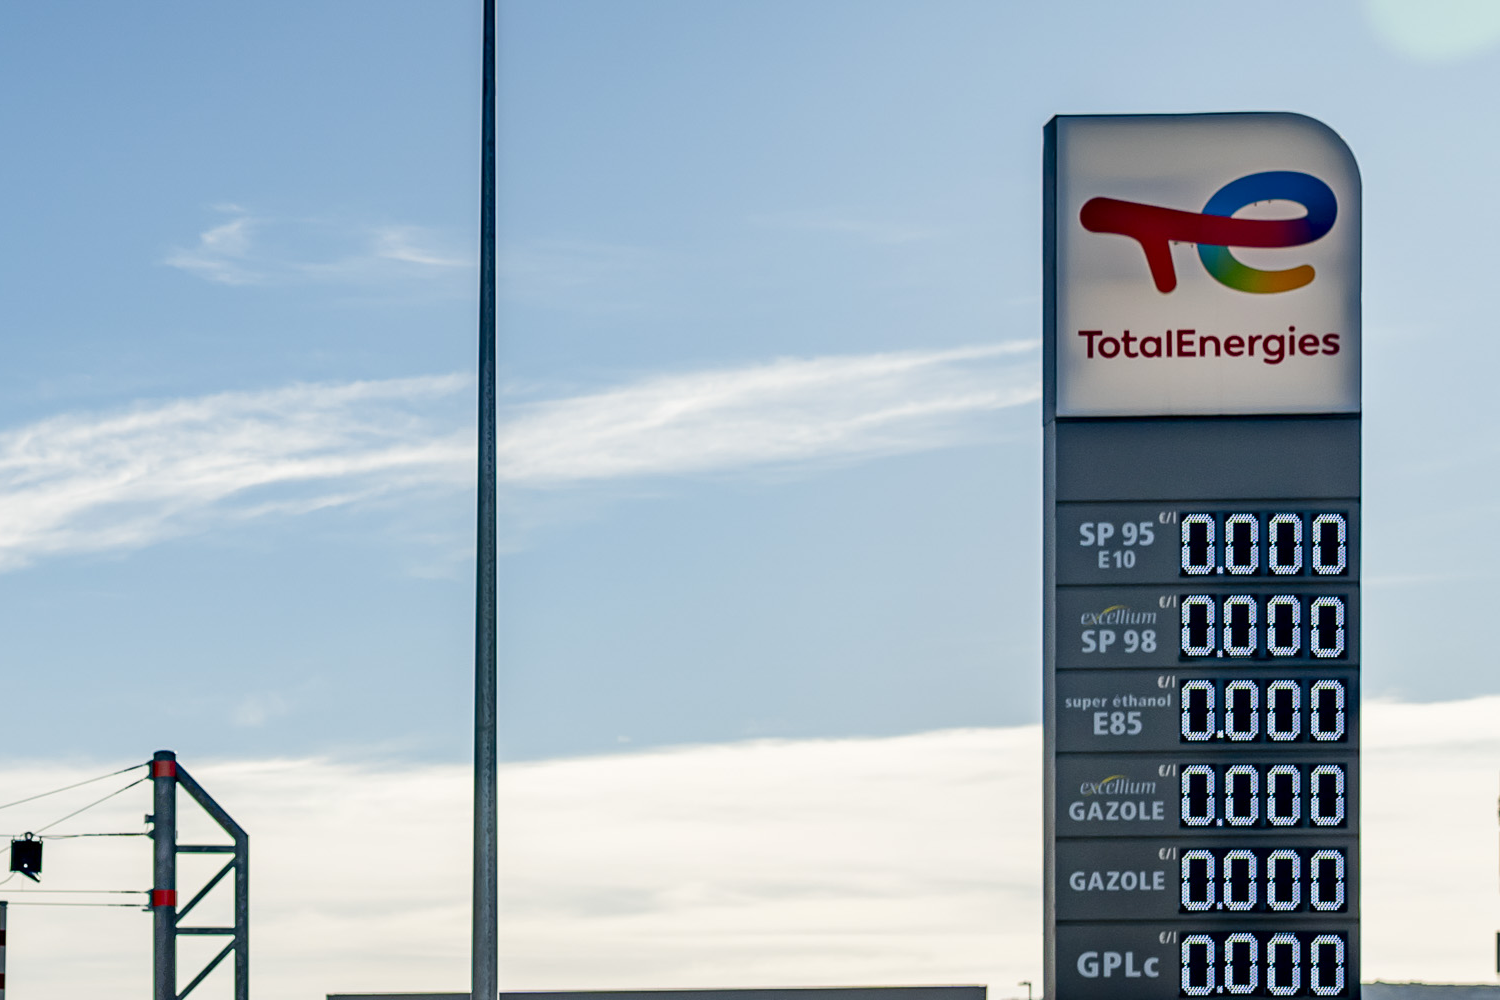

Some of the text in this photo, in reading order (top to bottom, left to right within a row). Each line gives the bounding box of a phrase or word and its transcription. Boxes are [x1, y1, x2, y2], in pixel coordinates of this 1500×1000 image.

[1078, 325, 1340, 365] TotalEnergies
[1079, 521, 1155, 546] SP 95
[1181, 512, 1346, 575] 0.000
[1080, 605, 1157, 626] excellium
[1181, 594, 1346, 658] 0.000
[1081, 630, 1157, 653] SP 98
[1065, 696, 1108, 710] super
[1181, 679, 1346, 741] 0.000
[1093, 712, 1143, 735] E85
[1080, 776, 1156, 796] excellium
[1181, 764, 1345, 826] 0.000
[1069, 801, 1165, 821] GAZOLE
[1069, 871, 1166, 891] GAZOLE
[1181, 849, 1345, 911] 0.000
[1076, 951, 1160, 978] GPLc
[1181, 932, 1345, 996] 0.000
